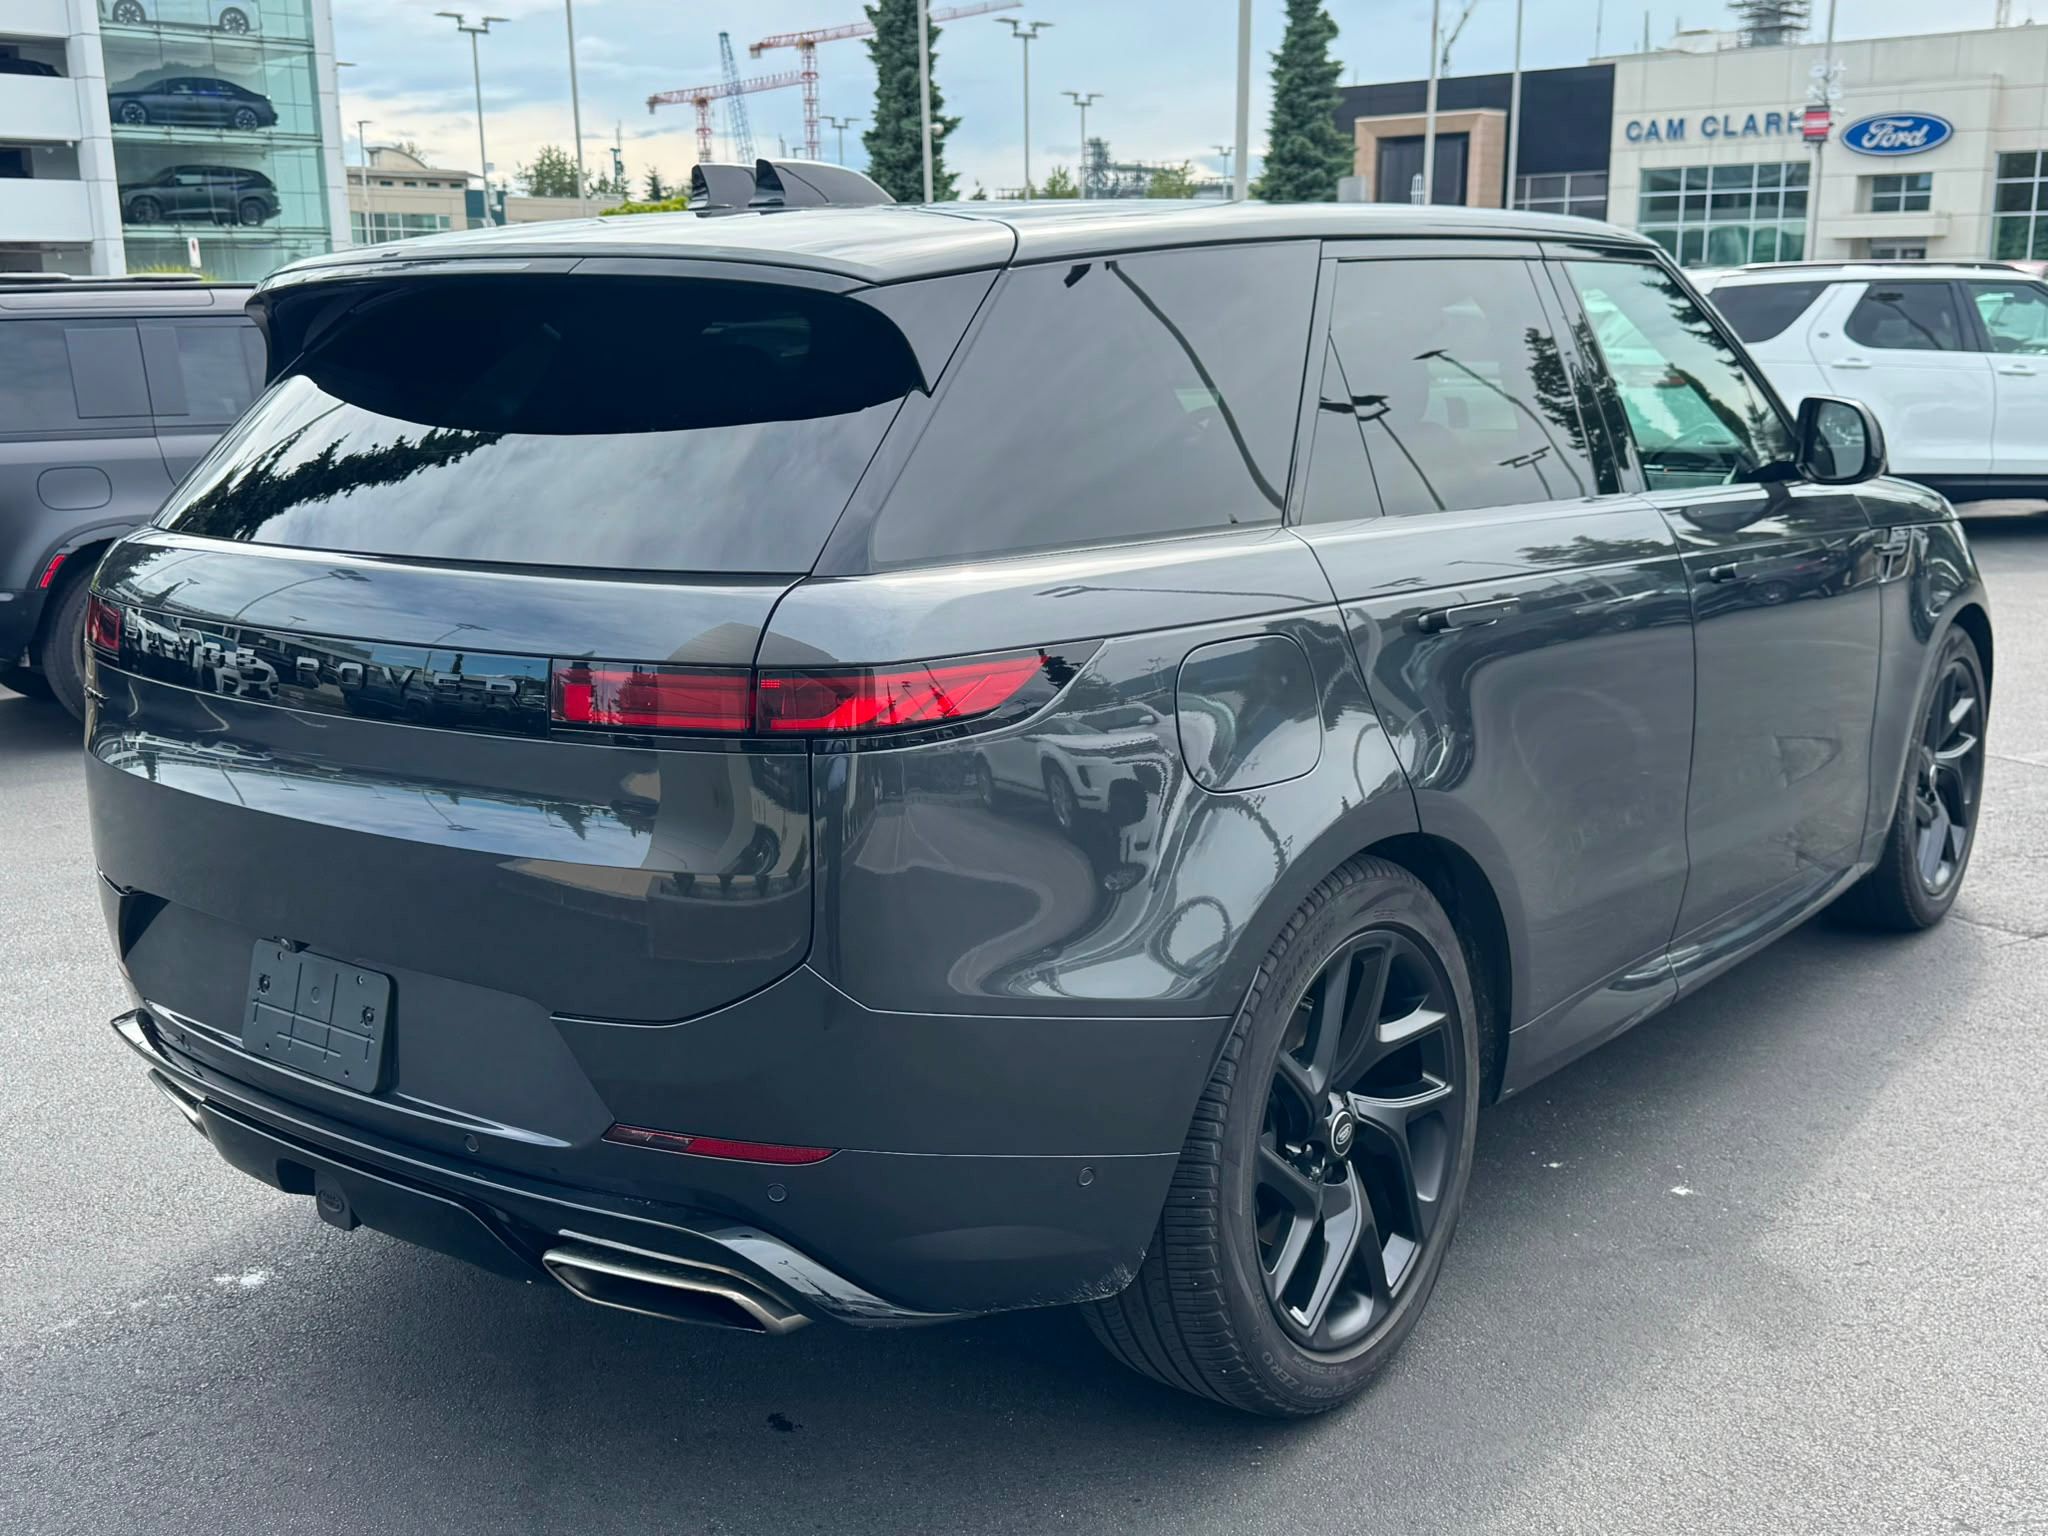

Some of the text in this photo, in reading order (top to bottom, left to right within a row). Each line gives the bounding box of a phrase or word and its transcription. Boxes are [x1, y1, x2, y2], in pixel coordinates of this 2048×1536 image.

[1625, 118, 1686, 143] CAM
[1861, 119, 1928, 149] Ford
[296, 656, 520, 708] ROVER
[1262, 1351, 1300, 1390] ZERO
